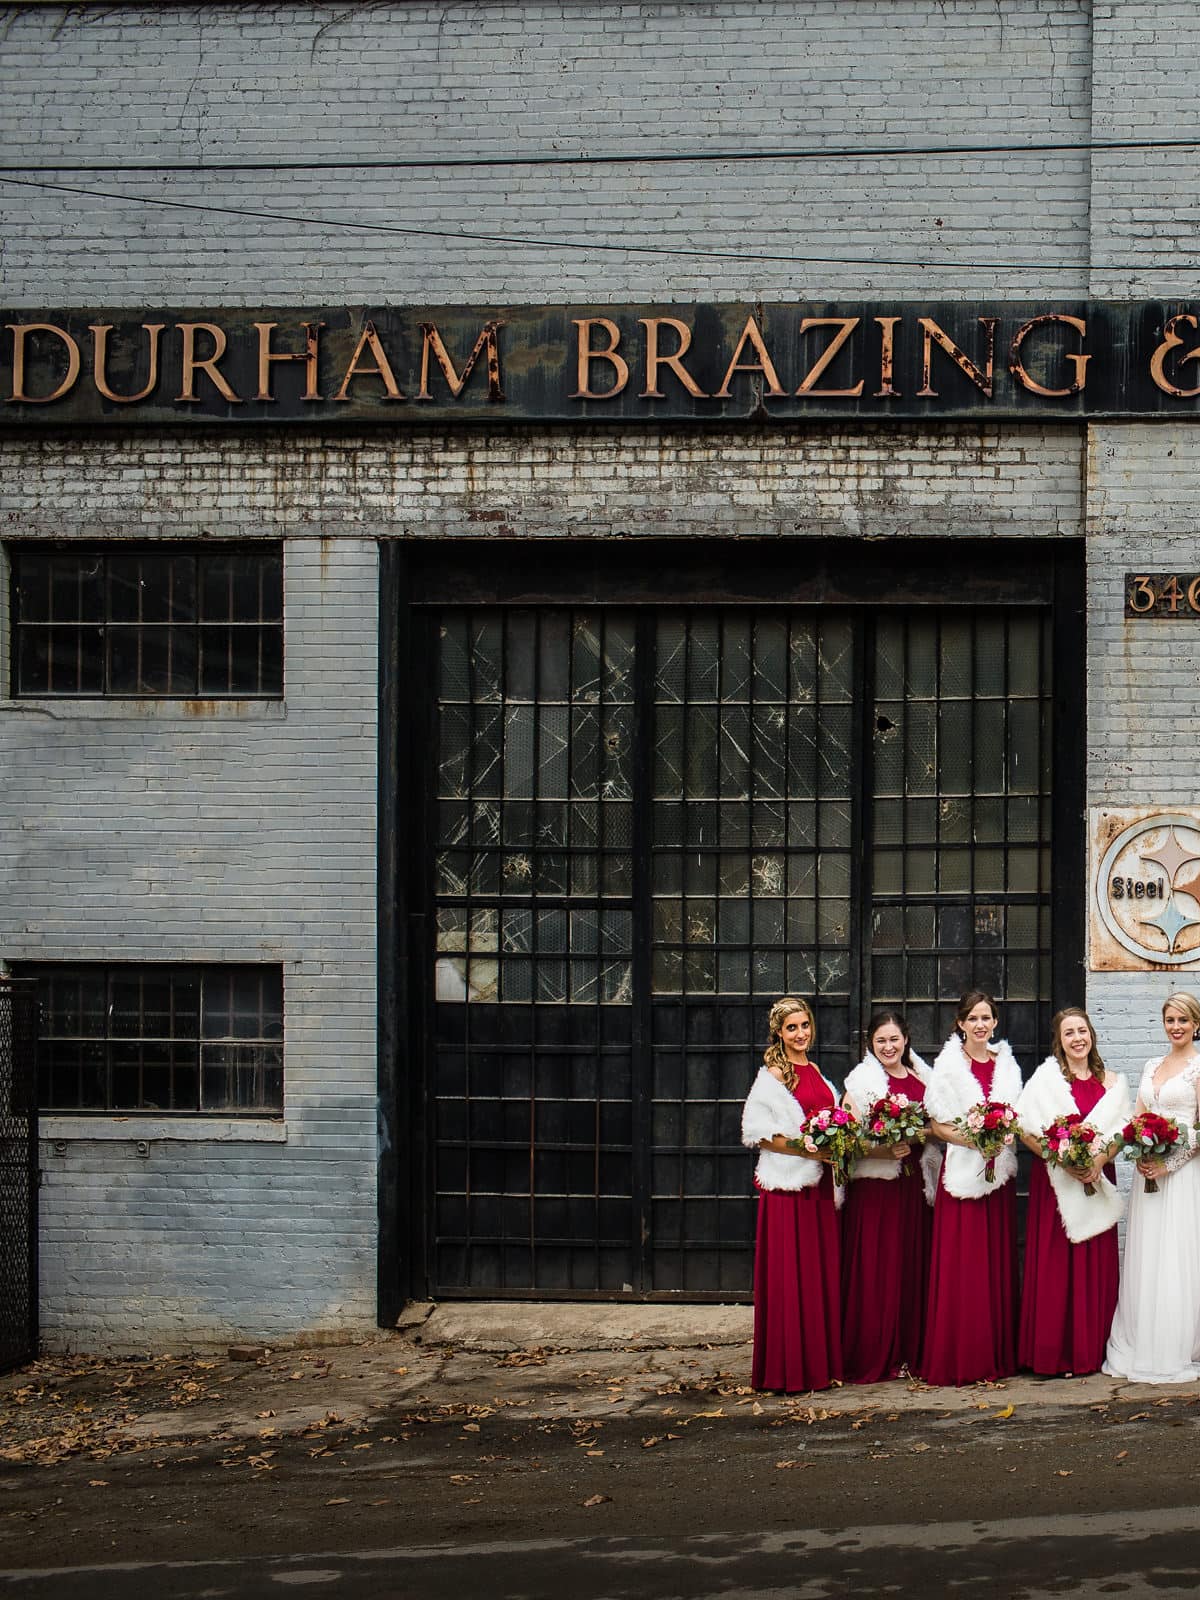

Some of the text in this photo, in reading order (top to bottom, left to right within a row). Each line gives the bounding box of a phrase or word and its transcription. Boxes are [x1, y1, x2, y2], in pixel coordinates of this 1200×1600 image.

[3, 319, 502, 403] DURHAM
[570, 315, 1092, 401] BRAZING
[1112, 877, 1164, 900] Steel
